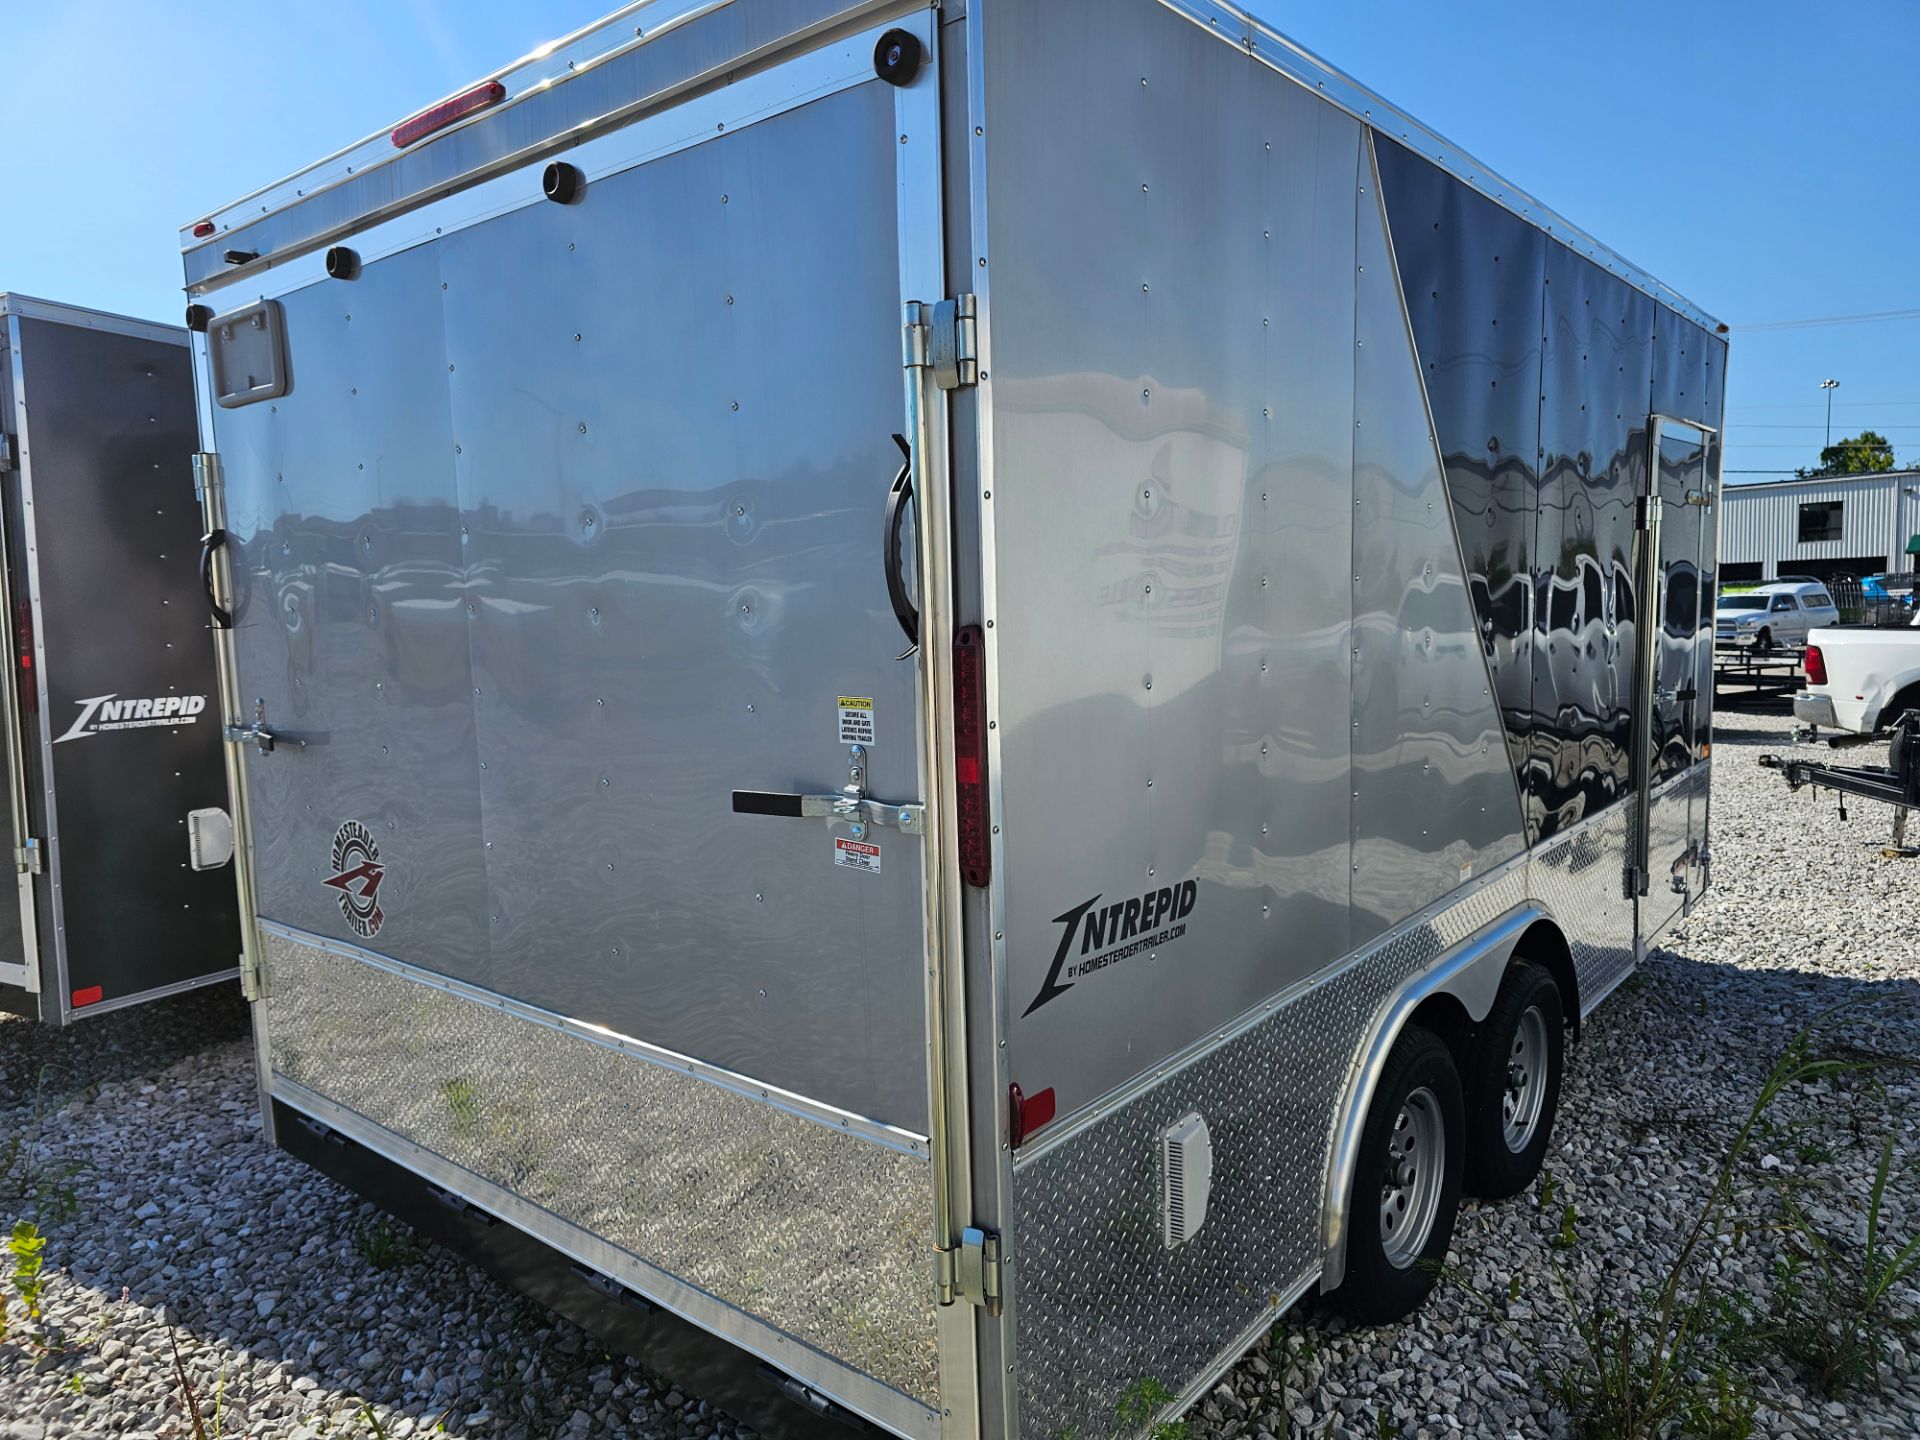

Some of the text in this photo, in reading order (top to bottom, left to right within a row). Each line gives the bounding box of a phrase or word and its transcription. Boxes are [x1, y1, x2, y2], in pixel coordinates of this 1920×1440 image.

[52, 693, 205, 744] INTREPID
[845, 700, 871, 708] CAUTION
[332, 821, 379, 872] HOMESTEADER
[847, 842, 874, 855] DANGER
[338, 893, 385, 937] TRAILER.COM
[1021, 879, 1197, 1019] INTREPID
[1068, 922, 1187, 978] BY HOMESTEADERTRAILER.COM
